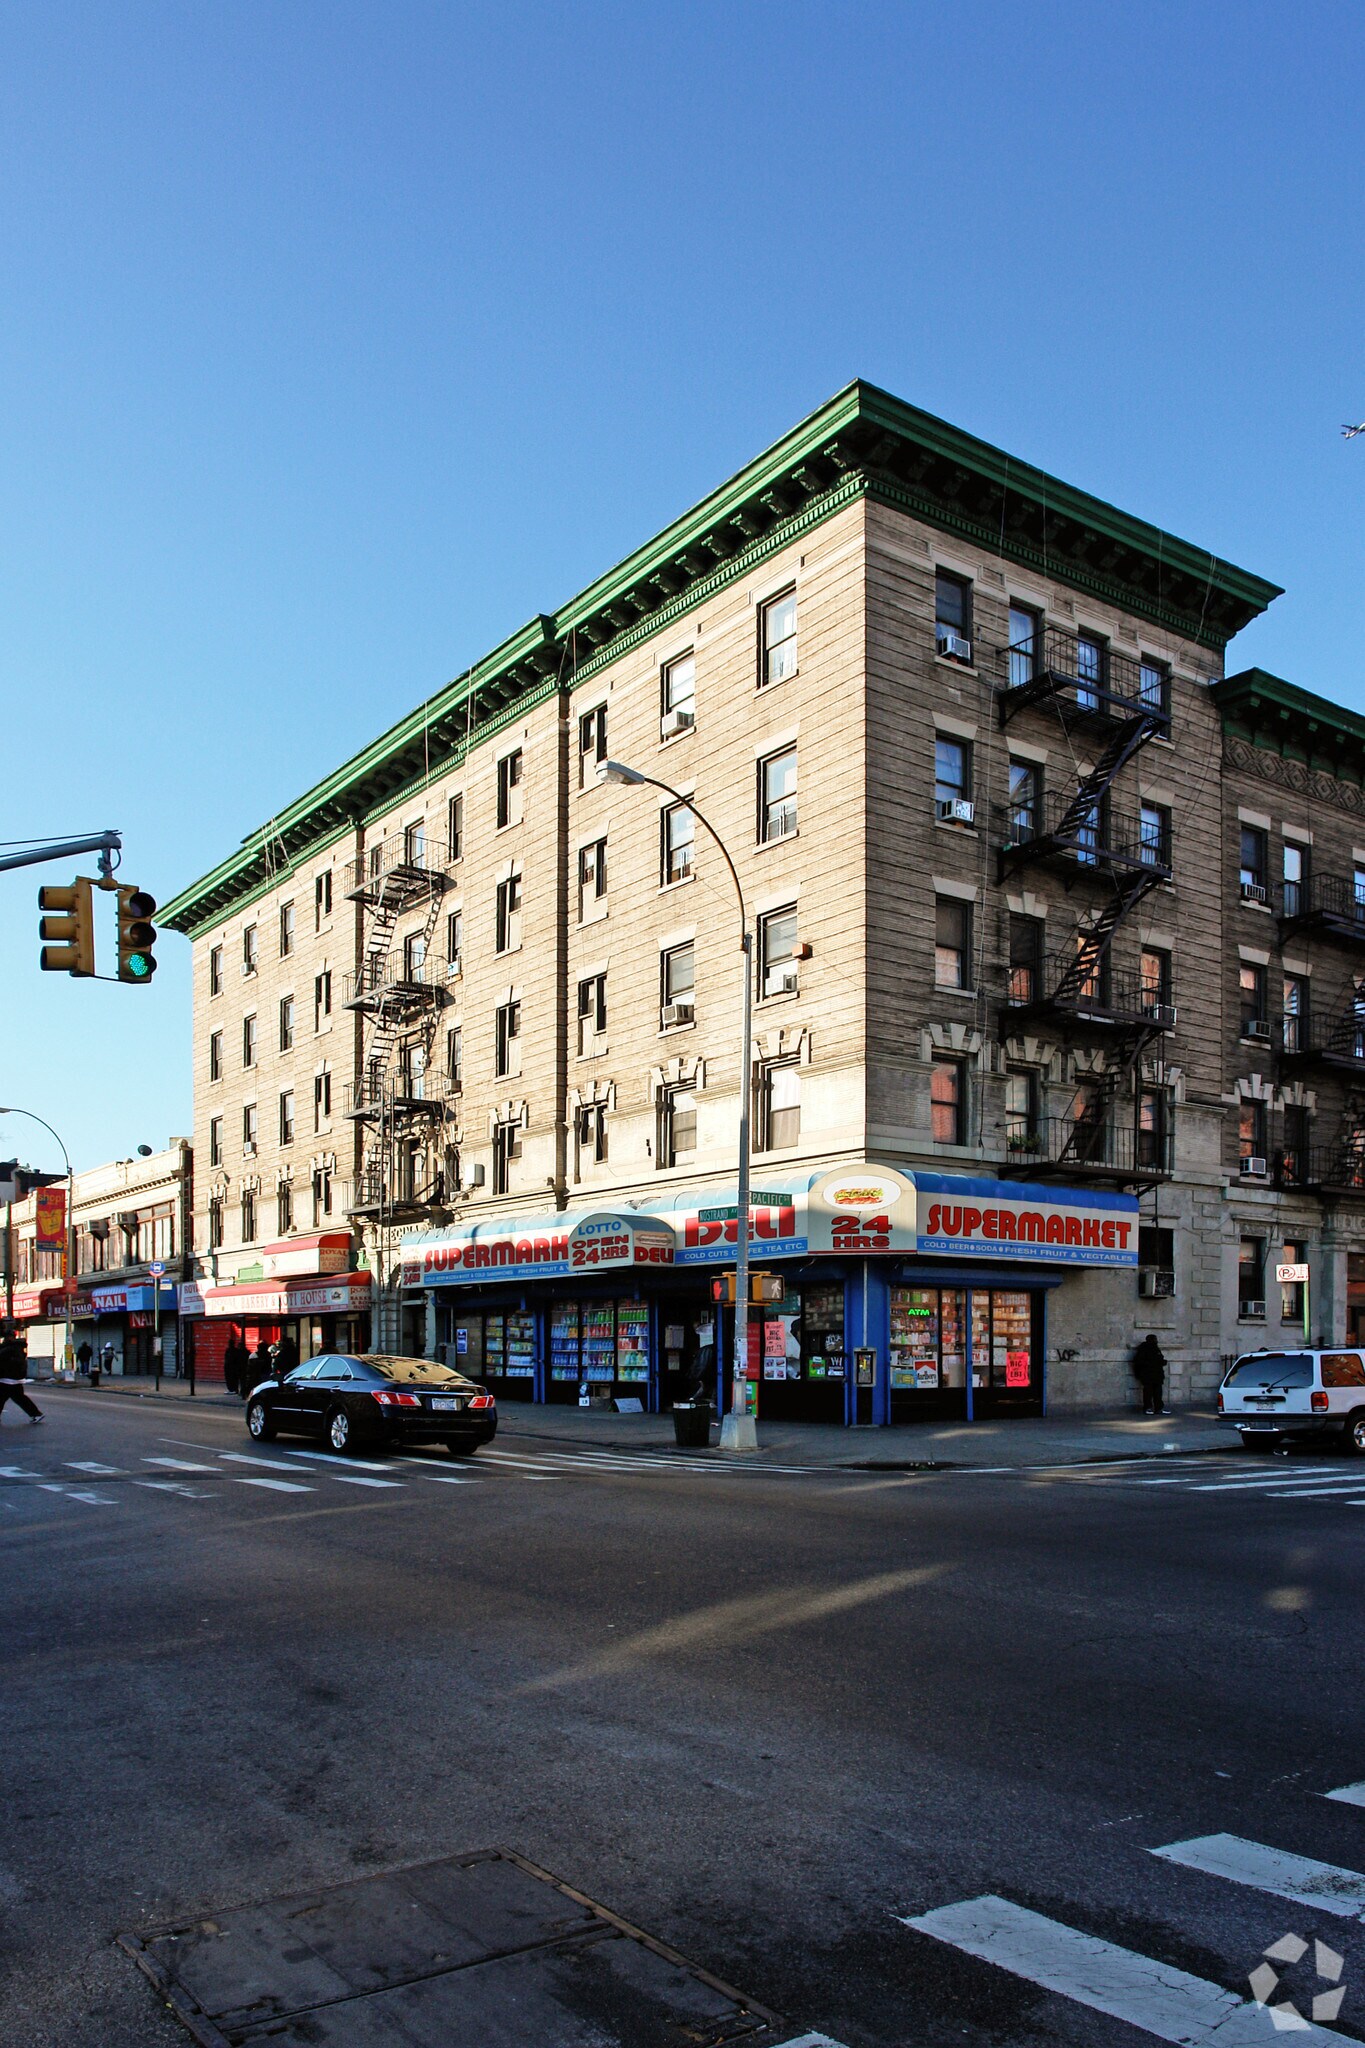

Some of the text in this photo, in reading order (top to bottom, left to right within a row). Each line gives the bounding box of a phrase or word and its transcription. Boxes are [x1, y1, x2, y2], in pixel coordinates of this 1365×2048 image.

[752, 1193, 783, 1205] PACIFIC
[700, 1209, 728, 1221] NOSTRAND
[578, 1221, 621, 1236] LOTTO
[831, 1215, 893, 1235] 24
[927, 1203, 1131, 1249] SUPERMARKET
[572, 1234, 629, 1249] OPEN
[833, 1236, 890, 1248] HRS
[320, 1249, 348, 1257] ROYAL
[424, 1234, 568, 1273] SUPERMARK
[572, 1245, 629, 1266] 24 HRS
[634, 1246, 674, 1264] DELI
[684, 1242, 805, 1260] COLD CUTS CFEE TEA ETC.
[924, 1240, 947, 1249] COLD
[949, 1242, 971, 1250] BEER
[975, 1245, 997, 1253] SODA
[1005, 1246, 1037, 1255] FRESH
[1040, 1249, 1068, 1257] FRUIT
[1080, 1252, 1133, 1262] VEGTABLES
[403, 1265, 420, 1273] OPEN
[94, 1294, 126, 1308] NAIL
[301, 1290, 327, 1304] HOUSE
[132, 1311, 155, 1327] NAI
[908, 1308, 930, 1316] ATM
